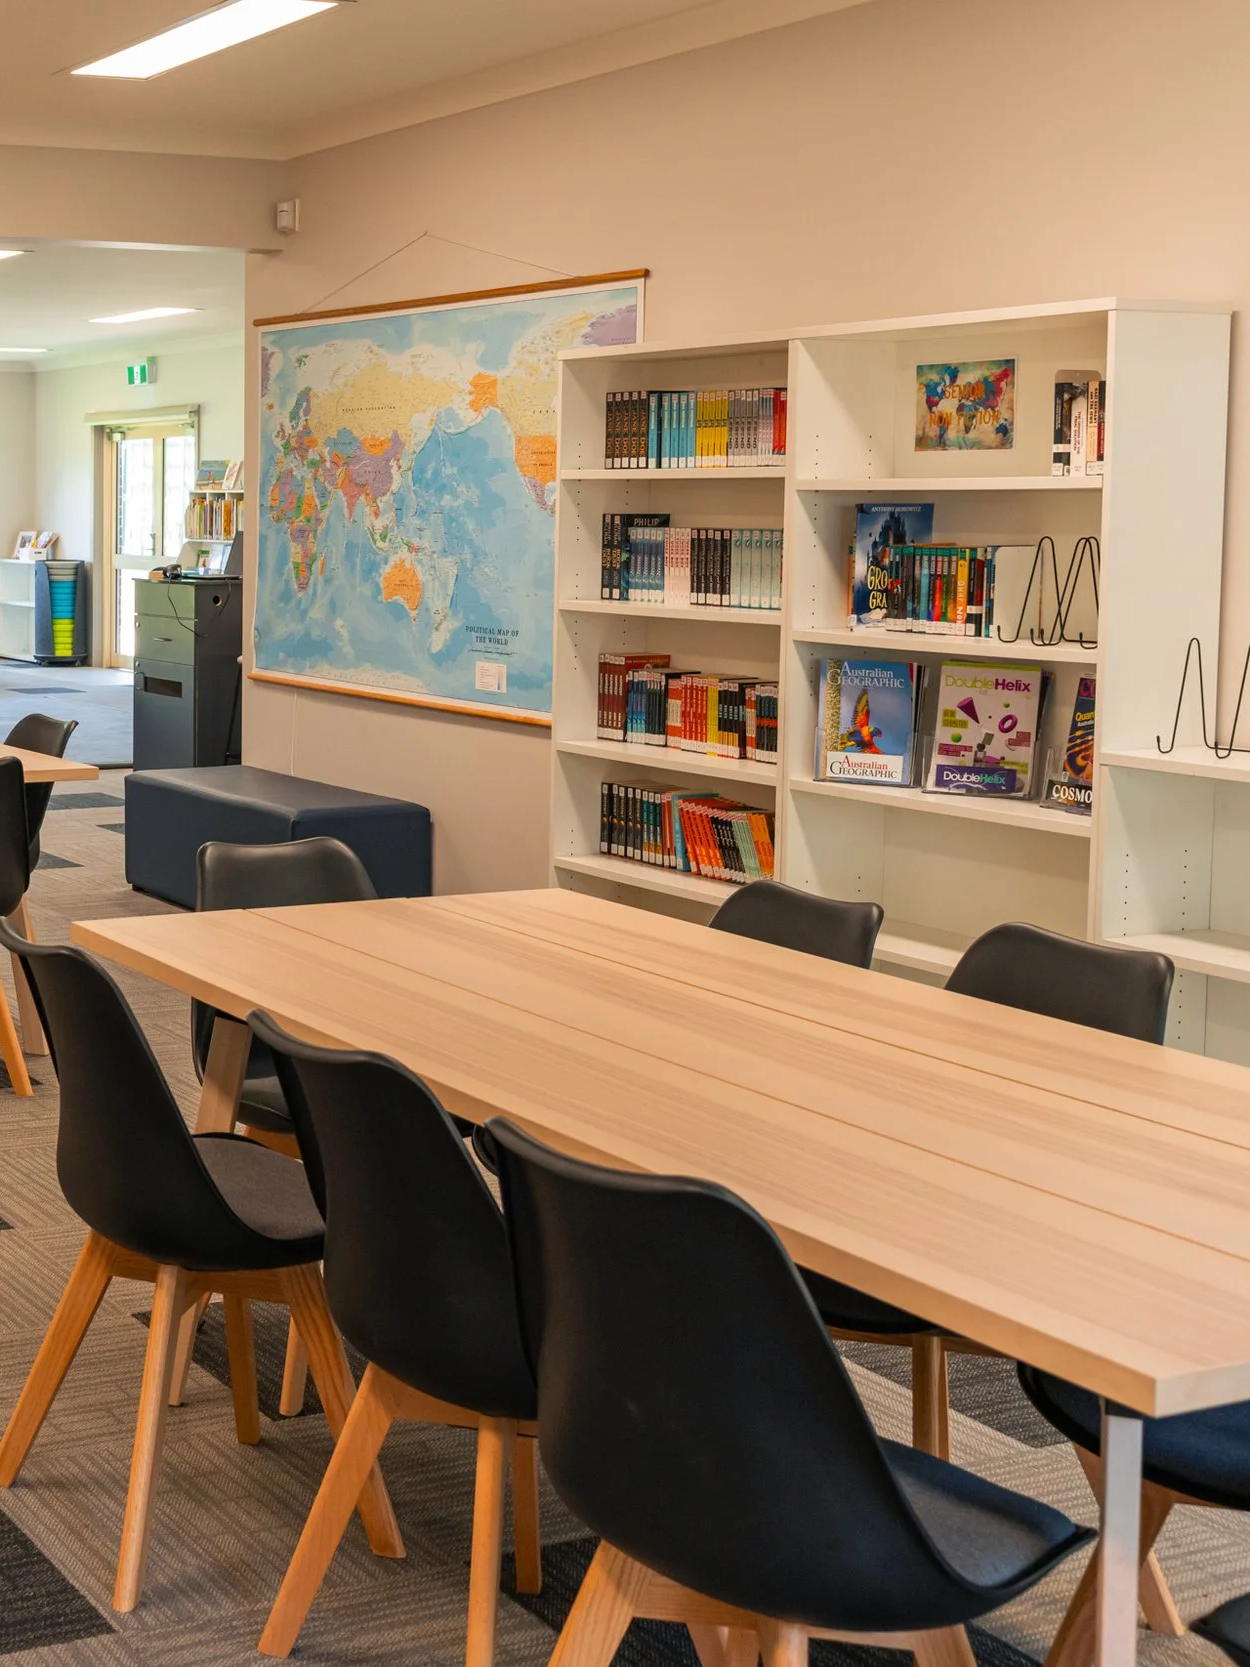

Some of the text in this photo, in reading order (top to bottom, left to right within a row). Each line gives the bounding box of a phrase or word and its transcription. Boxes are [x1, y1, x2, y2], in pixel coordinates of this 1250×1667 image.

[944, 383, 985, 400] SENIOR
[928, 410, 1000, 429] NON FICTION
[633, 518, 659, 527] PHILIP
[867, 565, 887, 590] GRO
[869, 591, 887, 609] GRA
[465, 626, 496, 635] POLITICAL
[497, 628, 510, 636] MAP
[488, 637, 508, 646] WORLD
[827, 669, 905, 688] GEOGRAPHIC
[840, 662, 893, 678] Australian
[830, 761, 898, 779] GEOGRAPHIC
[841, 755, 888, 769] Australian
[1052, 784, 1092, 803] COSMO
